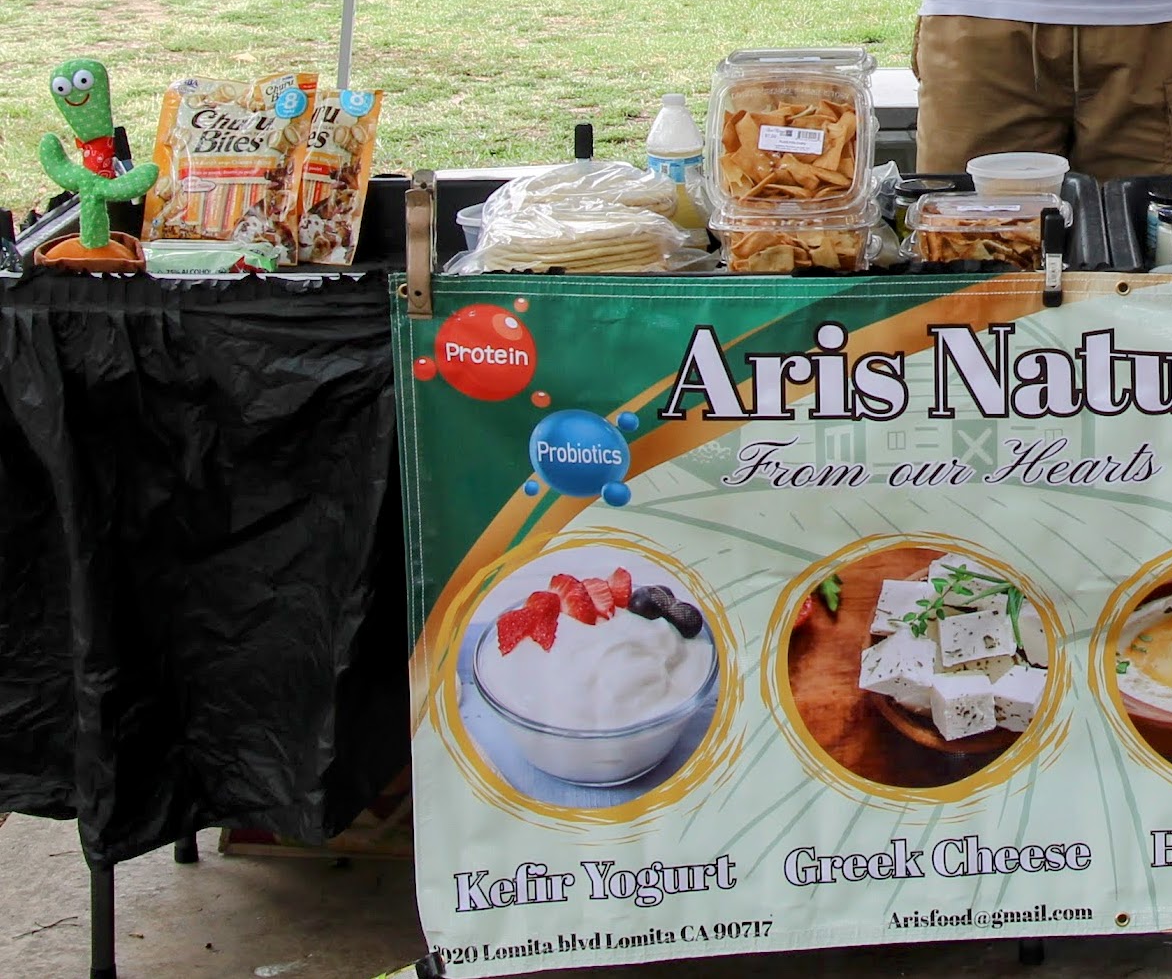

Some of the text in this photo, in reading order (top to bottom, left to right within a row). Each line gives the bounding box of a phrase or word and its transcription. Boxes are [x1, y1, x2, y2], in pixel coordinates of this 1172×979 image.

[283, 92, 298, 109] 8
[194, 130, 264, 153] Bites
[444, 340, 529, 368] Protein
[658, 323, 907, 421] Aris
[535, 439, 623, 467] Probiotics
[721, 436, 869, 490] From
[888, 460, 974, 489] our
[983, 436, 1161, 488] Hearts
[782, 834, 1093, 888] Greek Cheese
[453, 854, 738, 913] Kefir Yogurt
[887, 903, 1094, 932] Arisfood@gmail.com
[483, 938, 554, 962] Lomita
[556, 927, 602, 953] blvd
[604, 923, 677, 951] Lomita
[680, 921, 710, 943] CA
[713, 918, 774, 942] 90717
